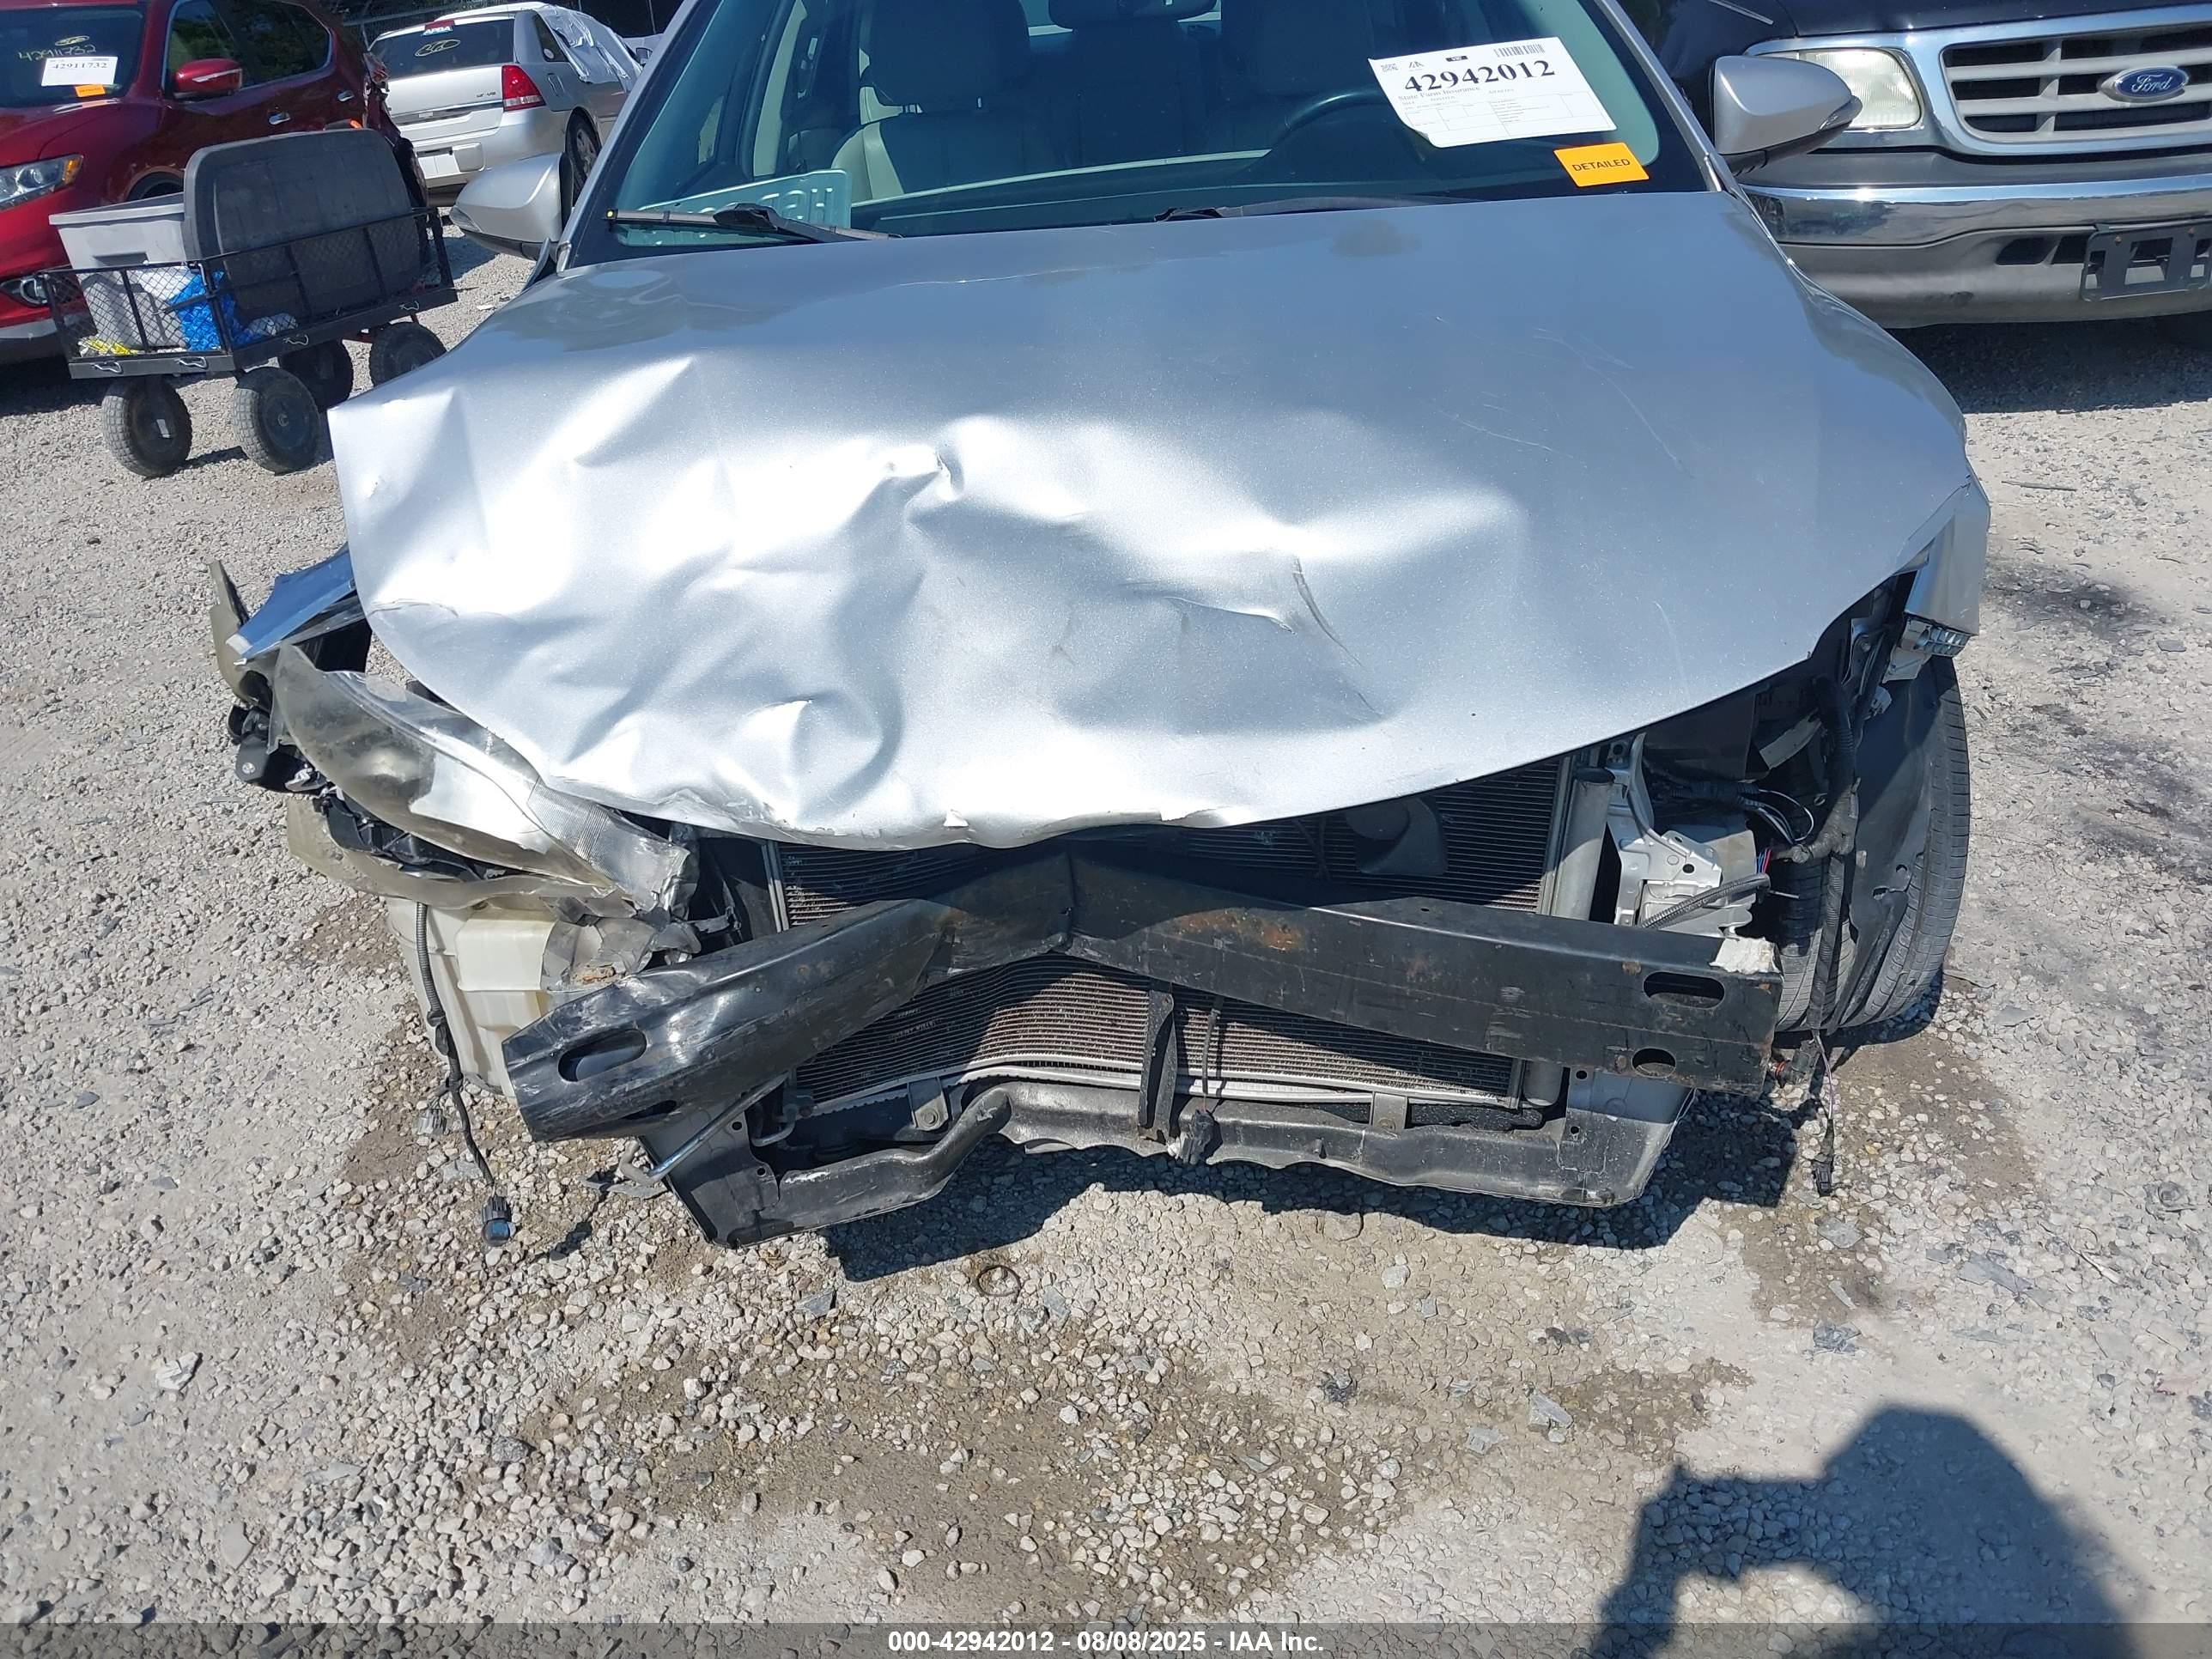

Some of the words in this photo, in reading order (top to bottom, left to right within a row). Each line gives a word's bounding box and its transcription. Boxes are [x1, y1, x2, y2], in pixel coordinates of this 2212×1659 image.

[1405, 60, 1556, 92] 42942012
[2131, 73, 2173, 93] Ford
[1571, 157, 1632, 173] DETAILED
